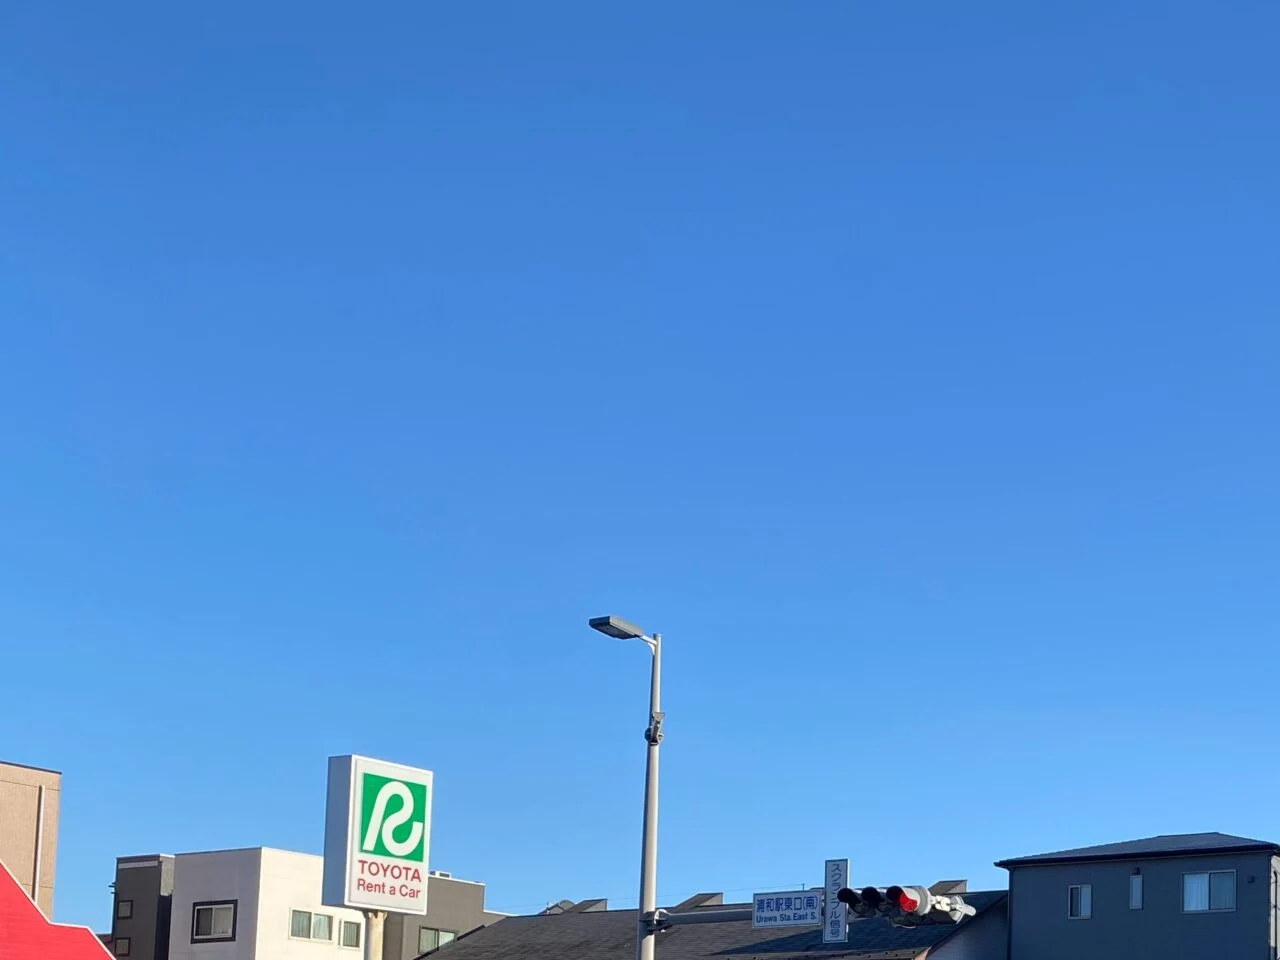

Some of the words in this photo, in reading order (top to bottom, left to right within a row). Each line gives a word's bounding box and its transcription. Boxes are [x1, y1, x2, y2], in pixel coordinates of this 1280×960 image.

[358, 860, 422, 883] TOYOTA
[357, 878, 386, 895] Rent
[388, 886, 396, 896] a
[398, 884, 421, 899] Car
[756, 895, 818, 913] 浦和駅東口(南)
[756, 914, 778, 924] Urawa
[793, 912, 808, 921] East
